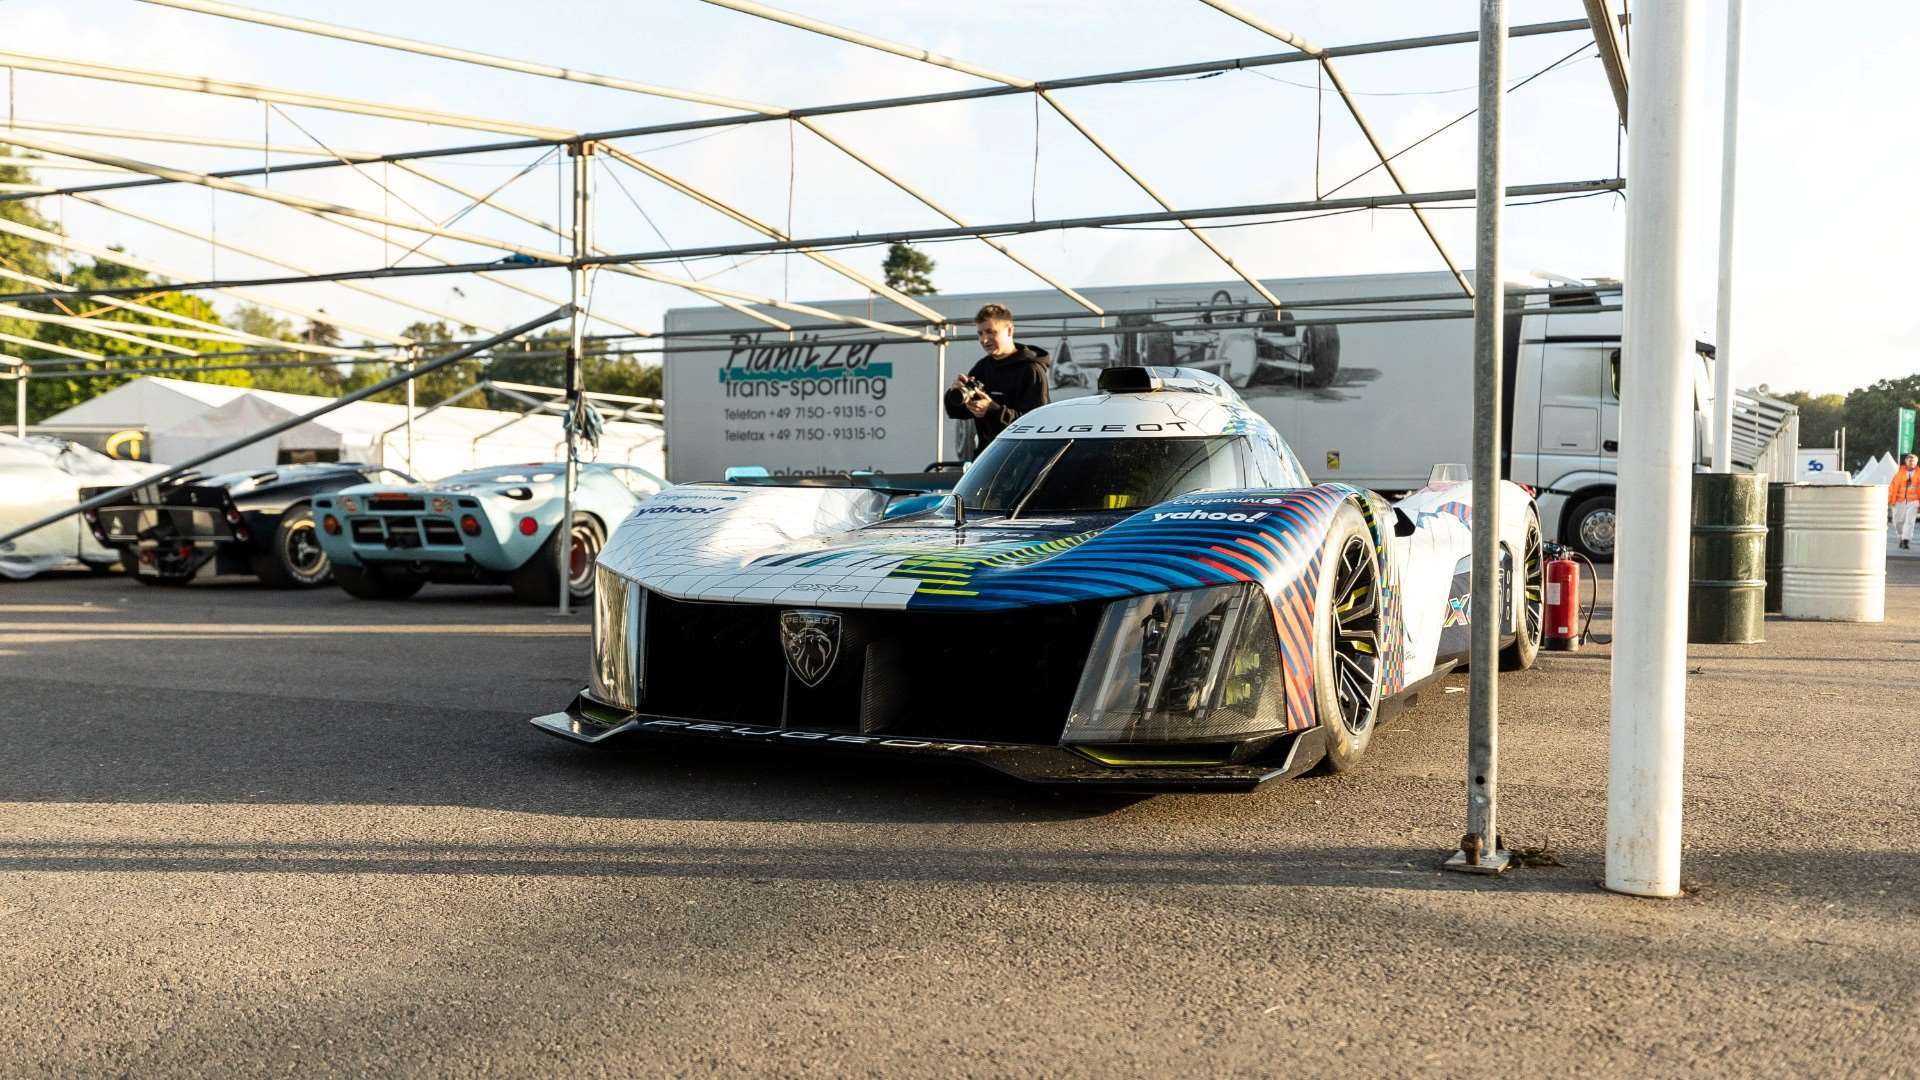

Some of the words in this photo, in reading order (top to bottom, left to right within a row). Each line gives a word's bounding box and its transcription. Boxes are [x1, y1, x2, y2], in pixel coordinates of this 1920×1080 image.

[726, 373, 887, 400] trans-sporting
[725, 408, 766, 420] Telefon
[770, 407, 791, 419] +49
[725, 429, 765, 442] Telefax
[770, 428, 791, 440] +49
[635, 505, 724, 517] yahoo!
[1152, 509, 1268, 523] yahoo!
[784, 616, 838, 624] PEUGEOT
[645, 719, 987, 750] PEUGEOT
